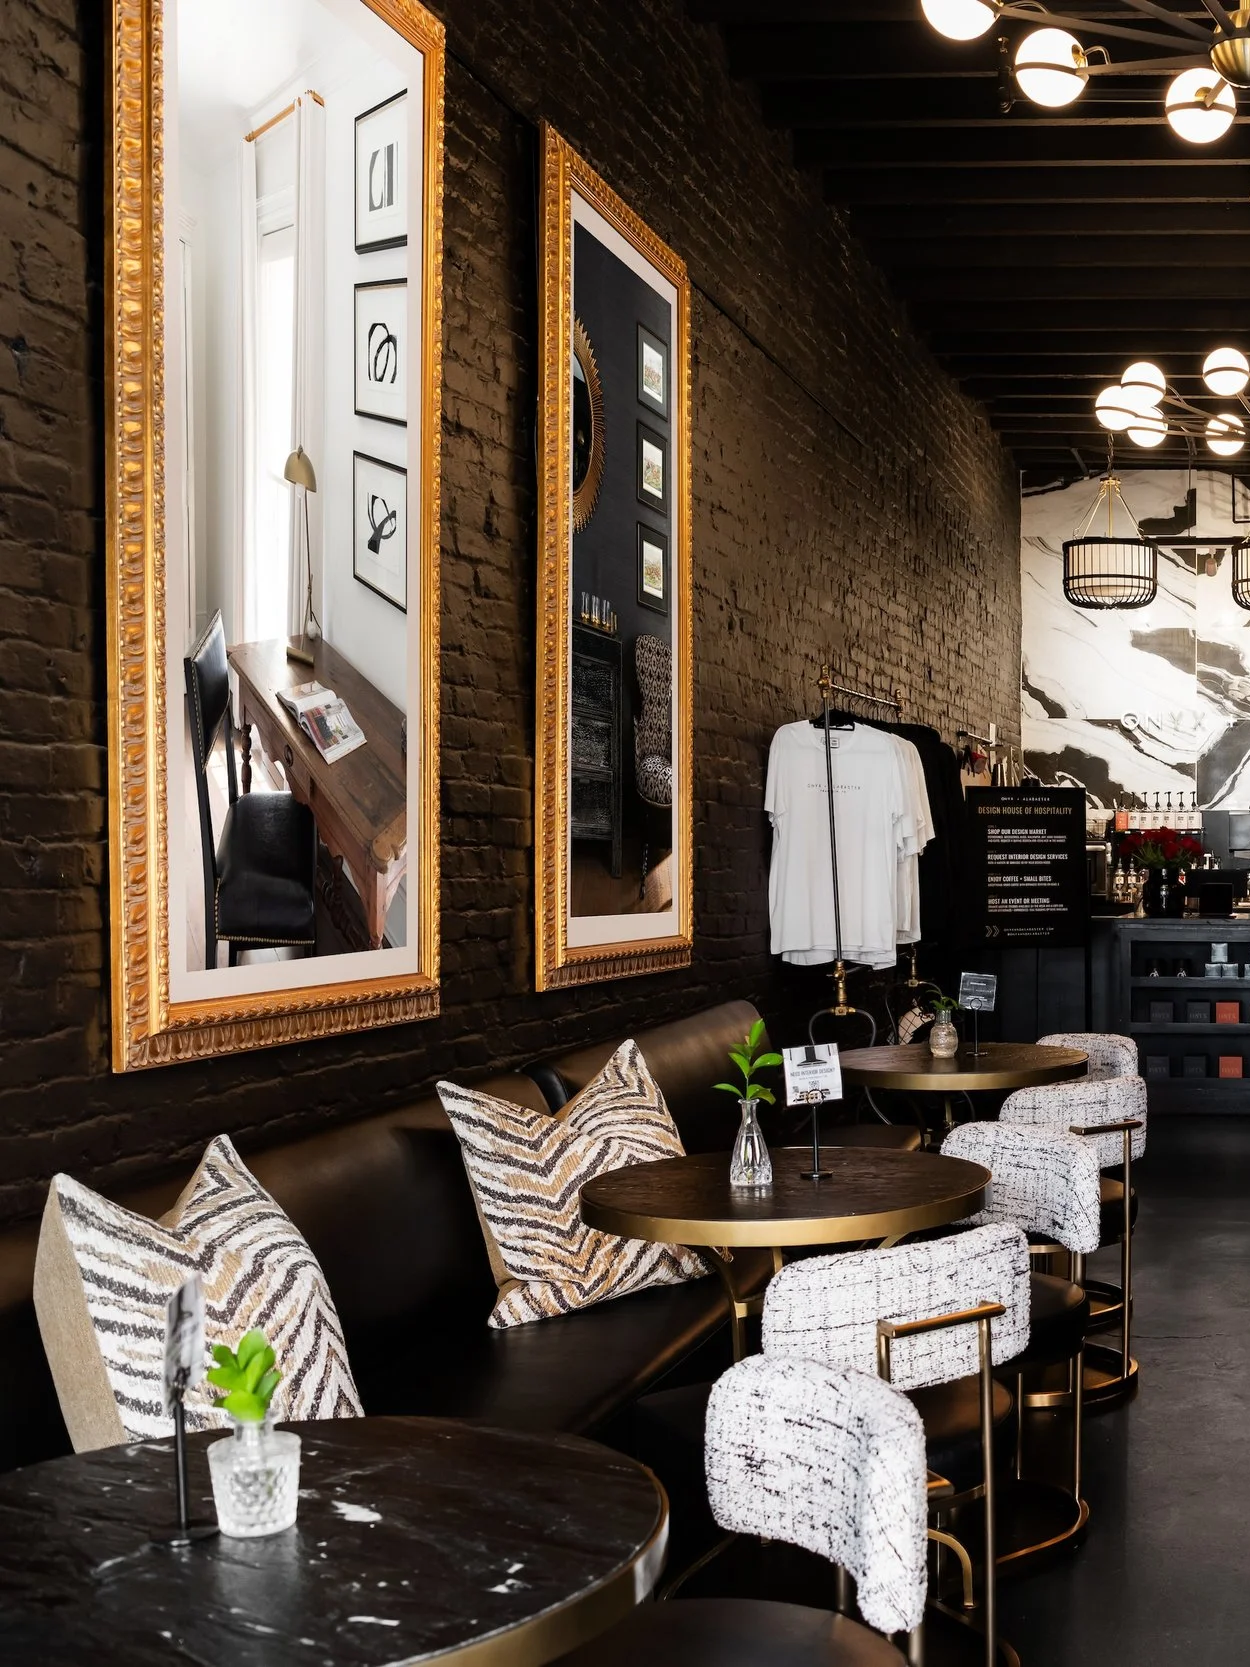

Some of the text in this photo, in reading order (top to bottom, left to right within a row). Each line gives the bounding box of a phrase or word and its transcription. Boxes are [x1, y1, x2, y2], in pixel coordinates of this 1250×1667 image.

[1120, 712, 1206, 731] ONYX
[978, 806, 1001, 814] DESIGN
[1034, 807, 1072, 815] HOSPITALITY
